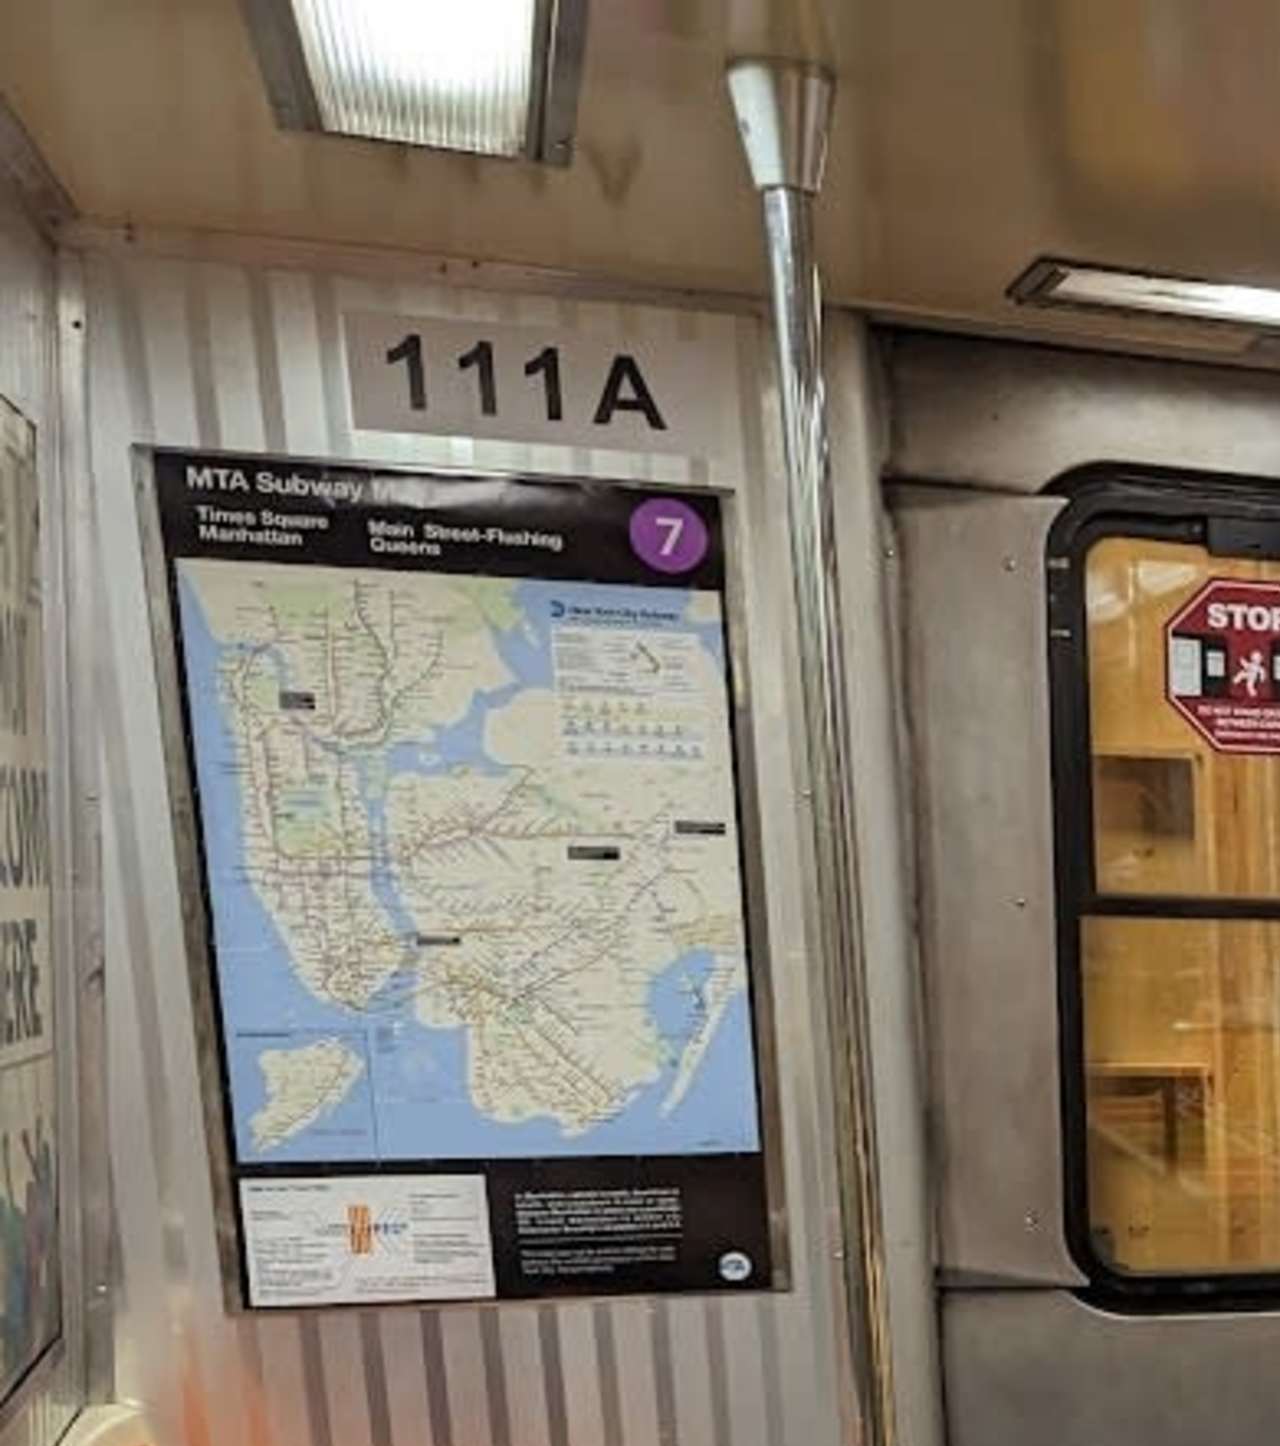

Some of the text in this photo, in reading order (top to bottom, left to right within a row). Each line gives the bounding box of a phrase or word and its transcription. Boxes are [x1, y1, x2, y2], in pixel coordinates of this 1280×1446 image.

[386, 334, 668, 431] 111A
[186, 466, 250, 492] MTA
[256, 471, 364, 502] Subway
[197, 504, 329, 531] Times Square
[367, 518, 415, 539] Main
[199, 525, 303, 546] Manhattan
[369, 537, 441, 556] Queens
[655, 516, 685, 557] 7
